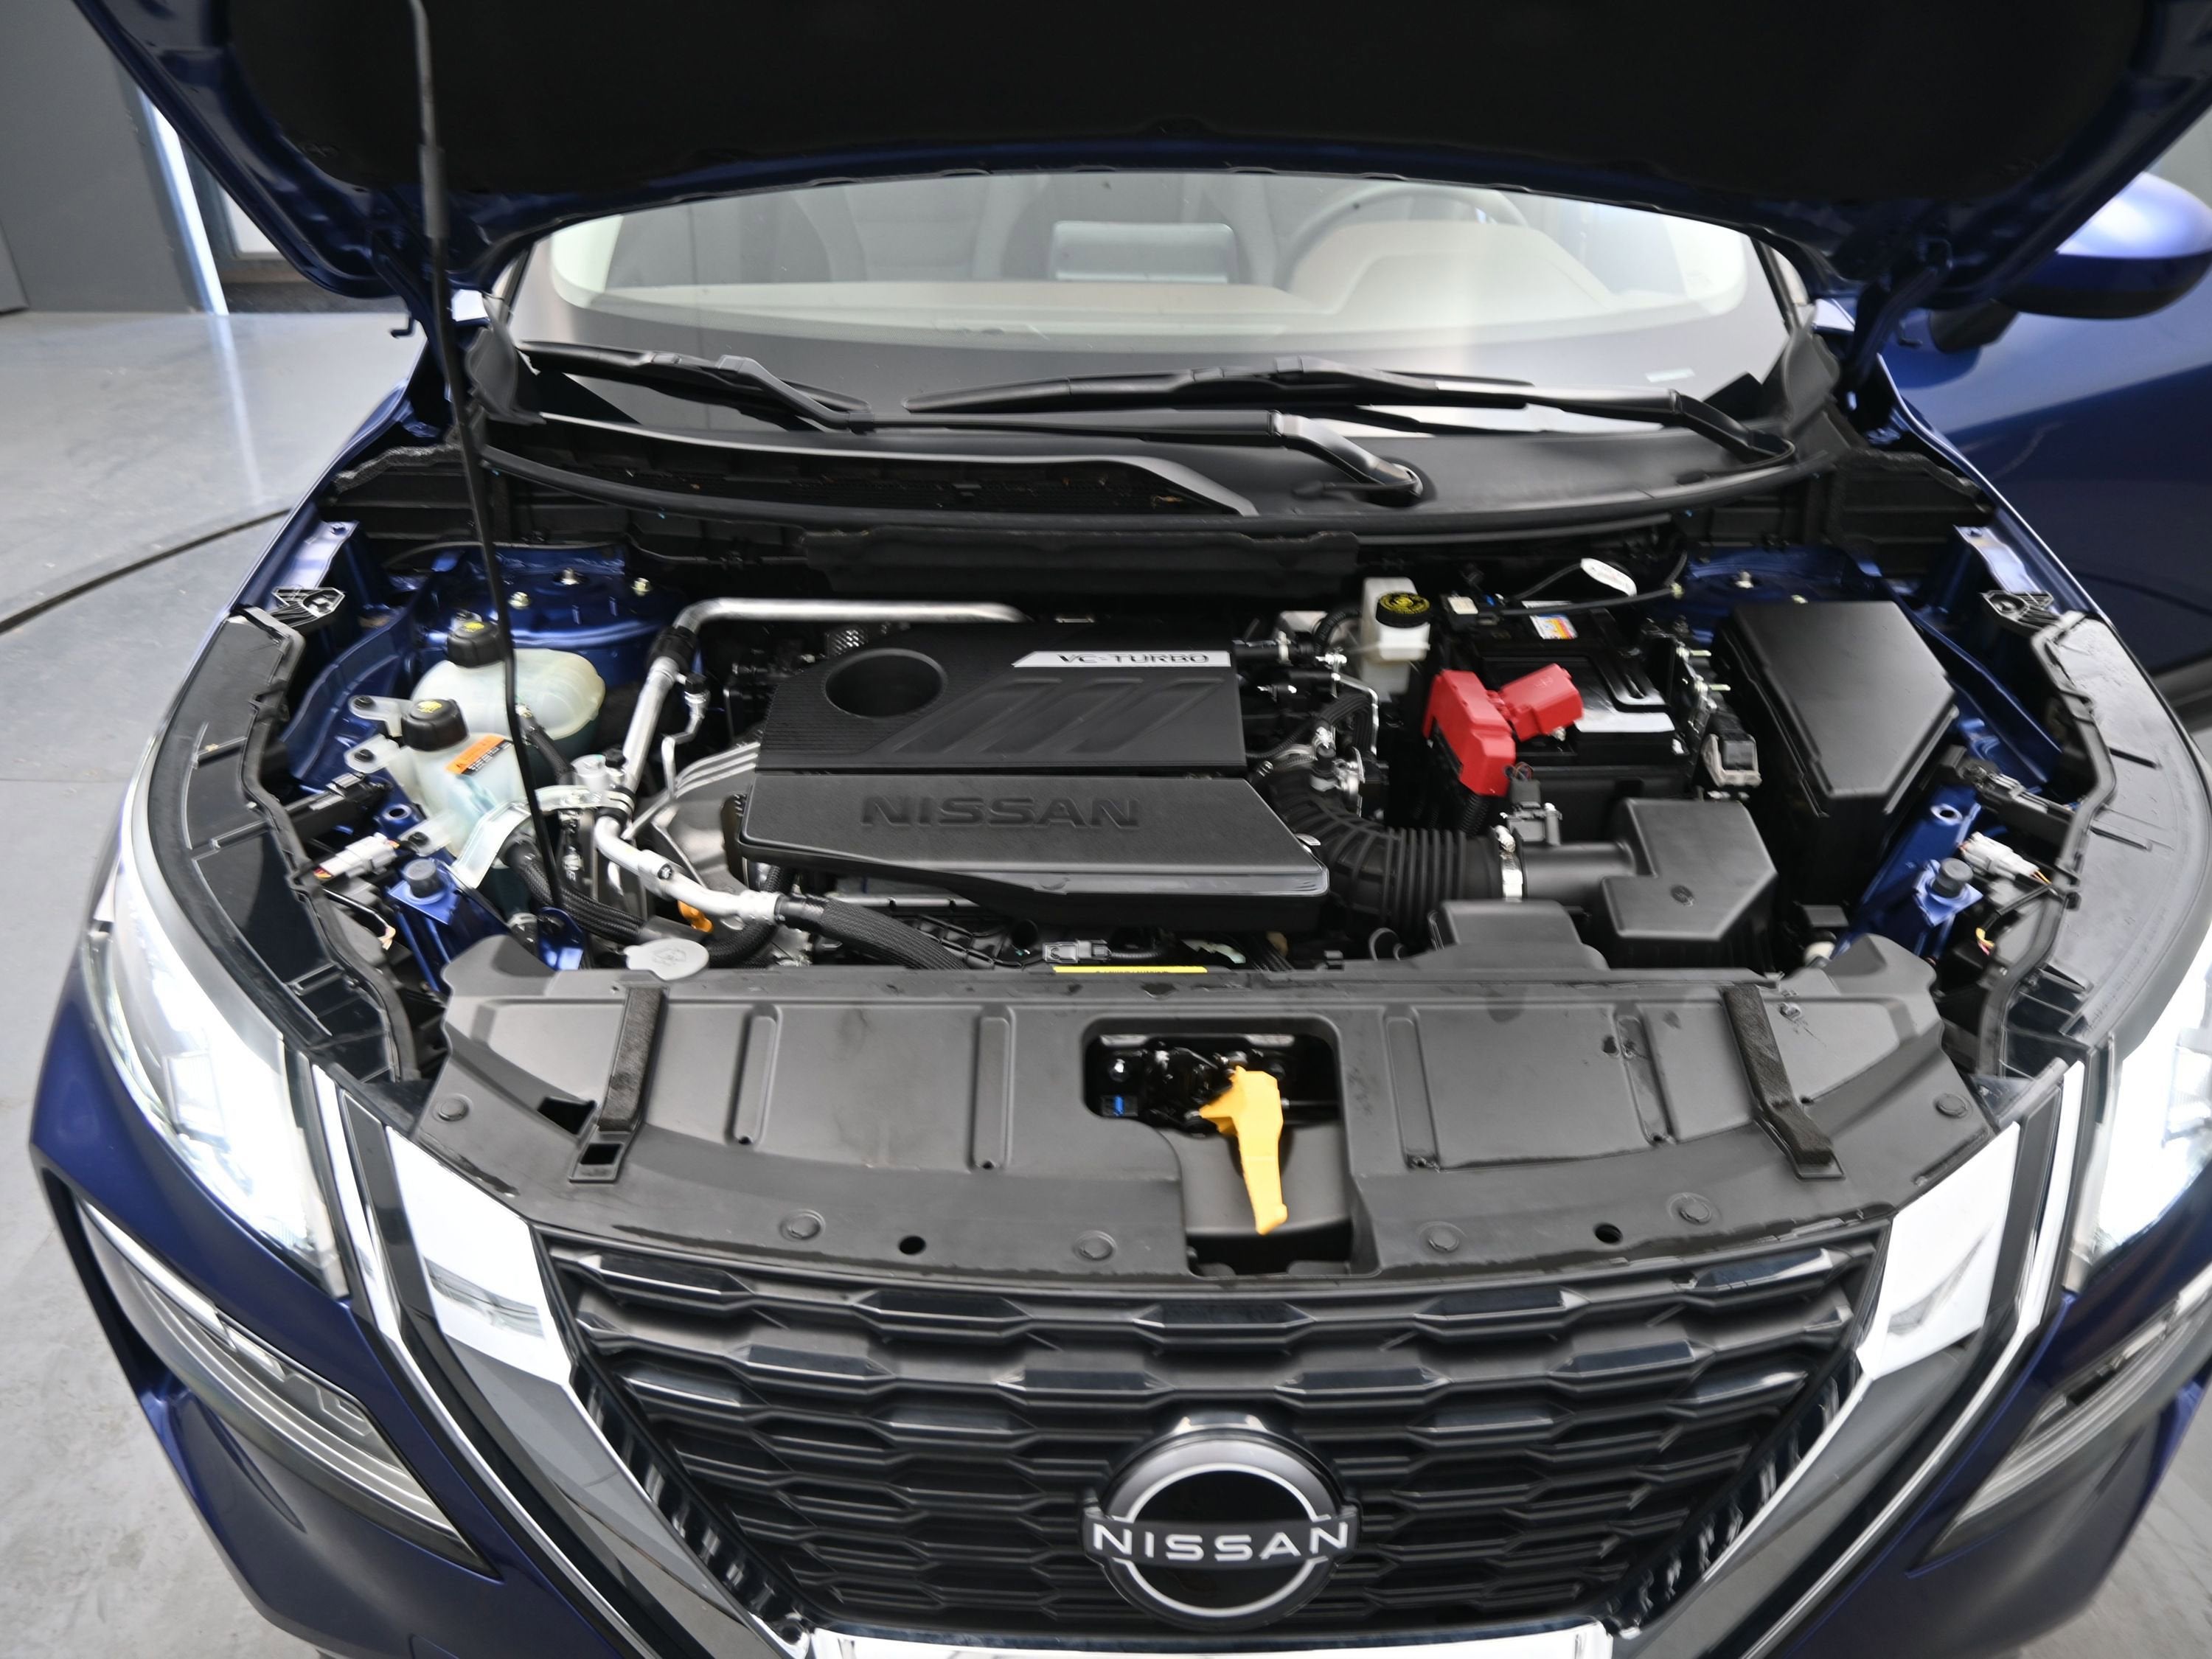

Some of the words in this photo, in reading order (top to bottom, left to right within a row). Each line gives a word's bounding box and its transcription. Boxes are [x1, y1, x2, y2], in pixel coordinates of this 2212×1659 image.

[1057, 653, 1209, 664] VC-TURBO
[861, 796, 1139, 829] NISSAN
[1093, 1522, 1348, 1561] NISSAN
